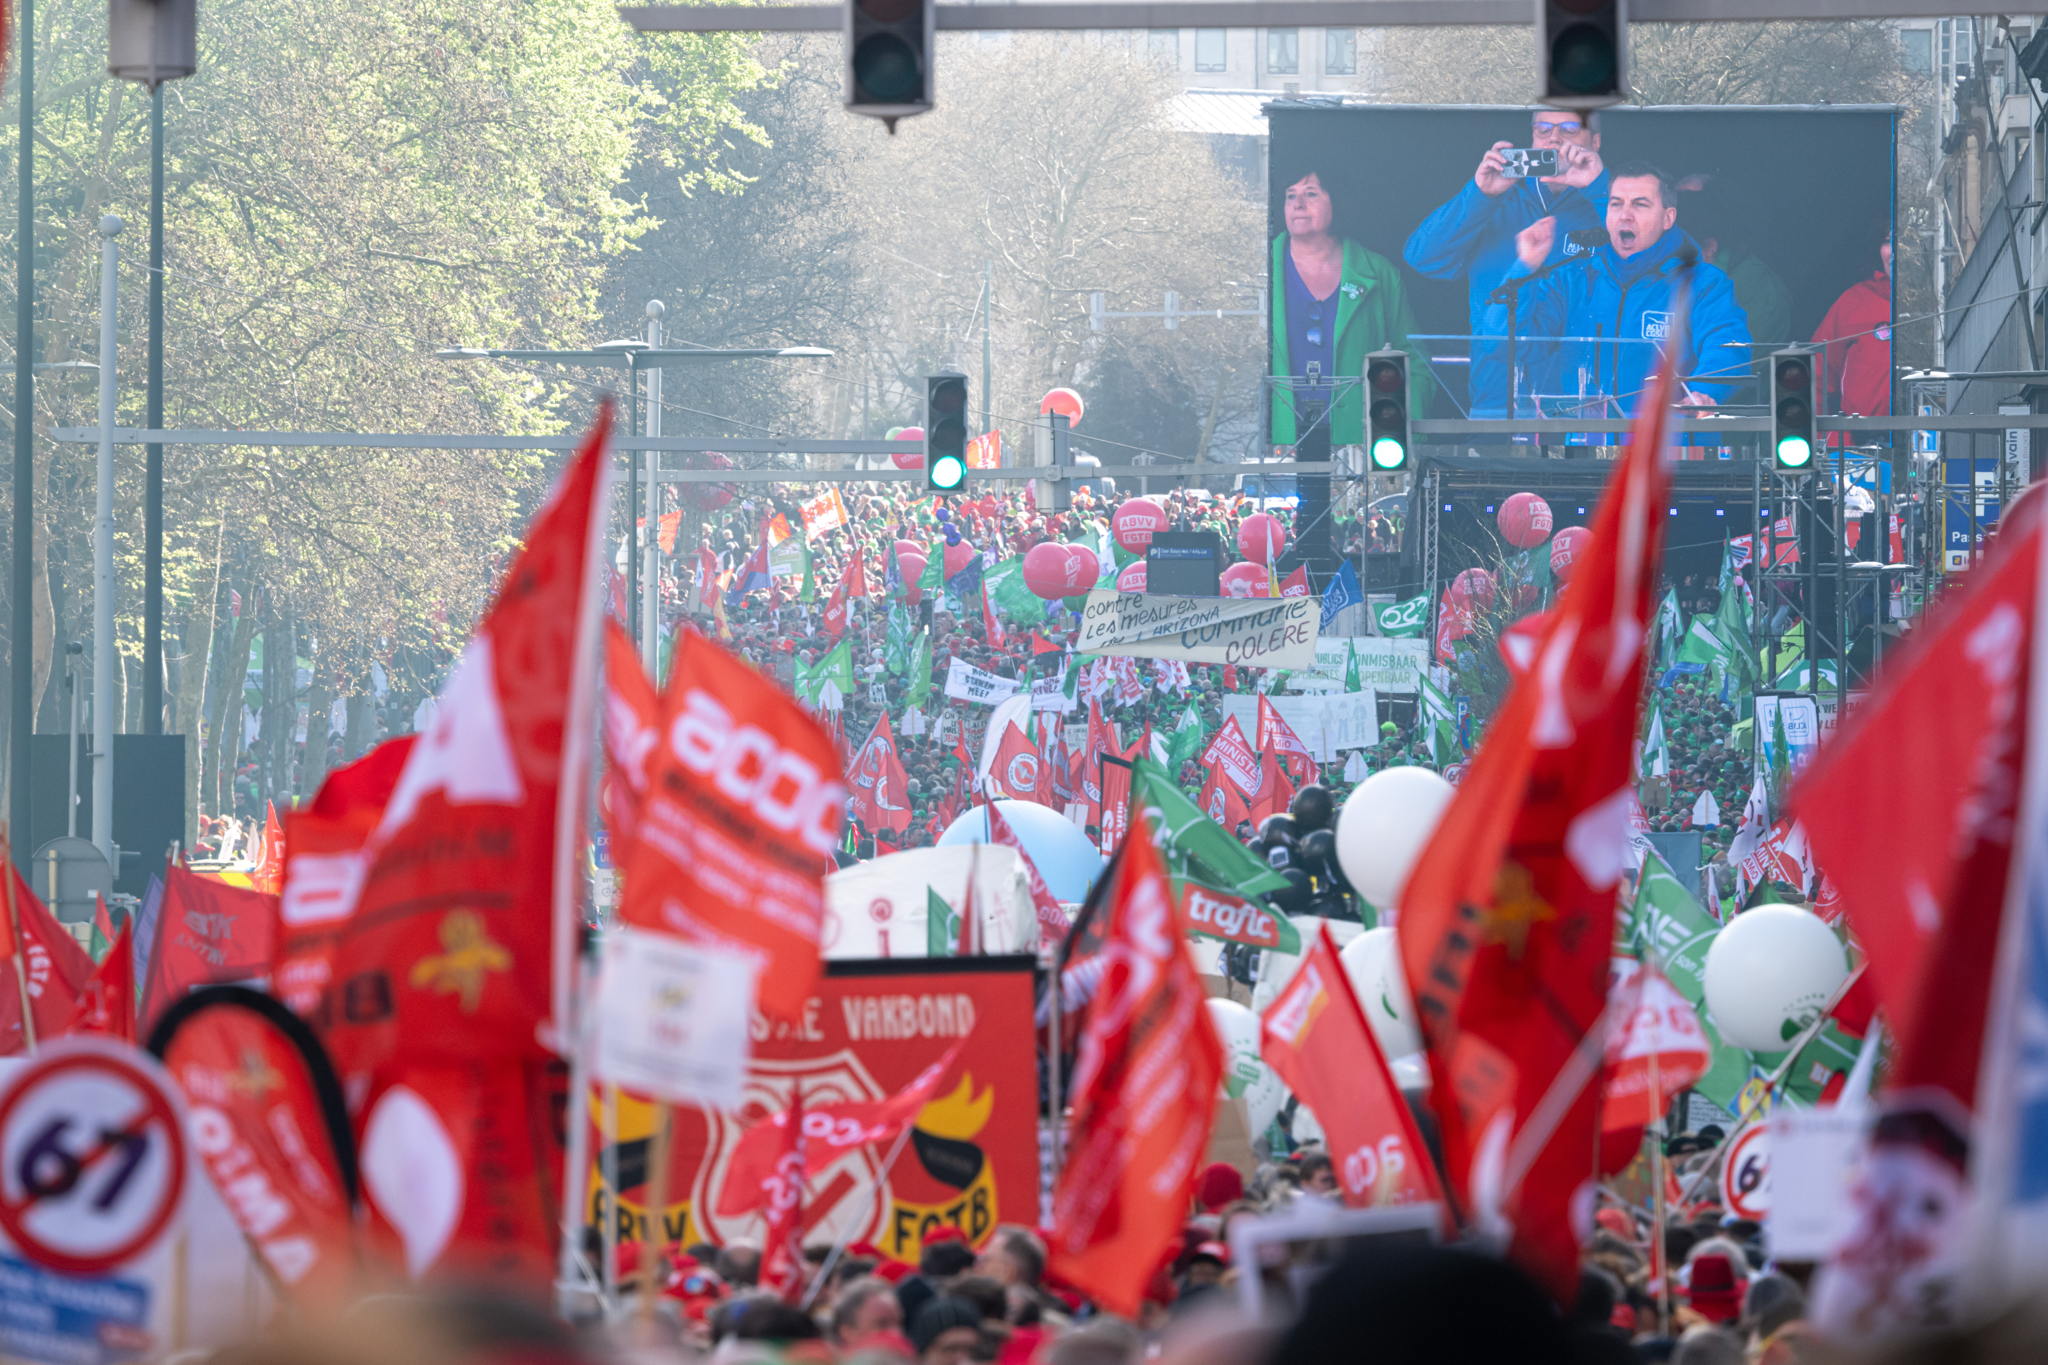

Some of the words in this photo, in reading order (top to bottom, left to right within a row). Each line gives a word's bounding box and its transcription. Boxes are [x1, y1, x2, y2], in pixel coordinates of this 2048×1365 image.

[1121, 519, 1154, 530] ABVV
[1124, 576, 1147, 587] ABV
[1086, 593, 1143, 619] contre
[1120, 598, 1198, 631] mesures
[1226, 620, 1311, 664] COLERE
[1189, 892, 1272, 939] trafic
[841, 993, 976, 1041] VAKBOND
[1738, 1154, 1762, 1194] 6
